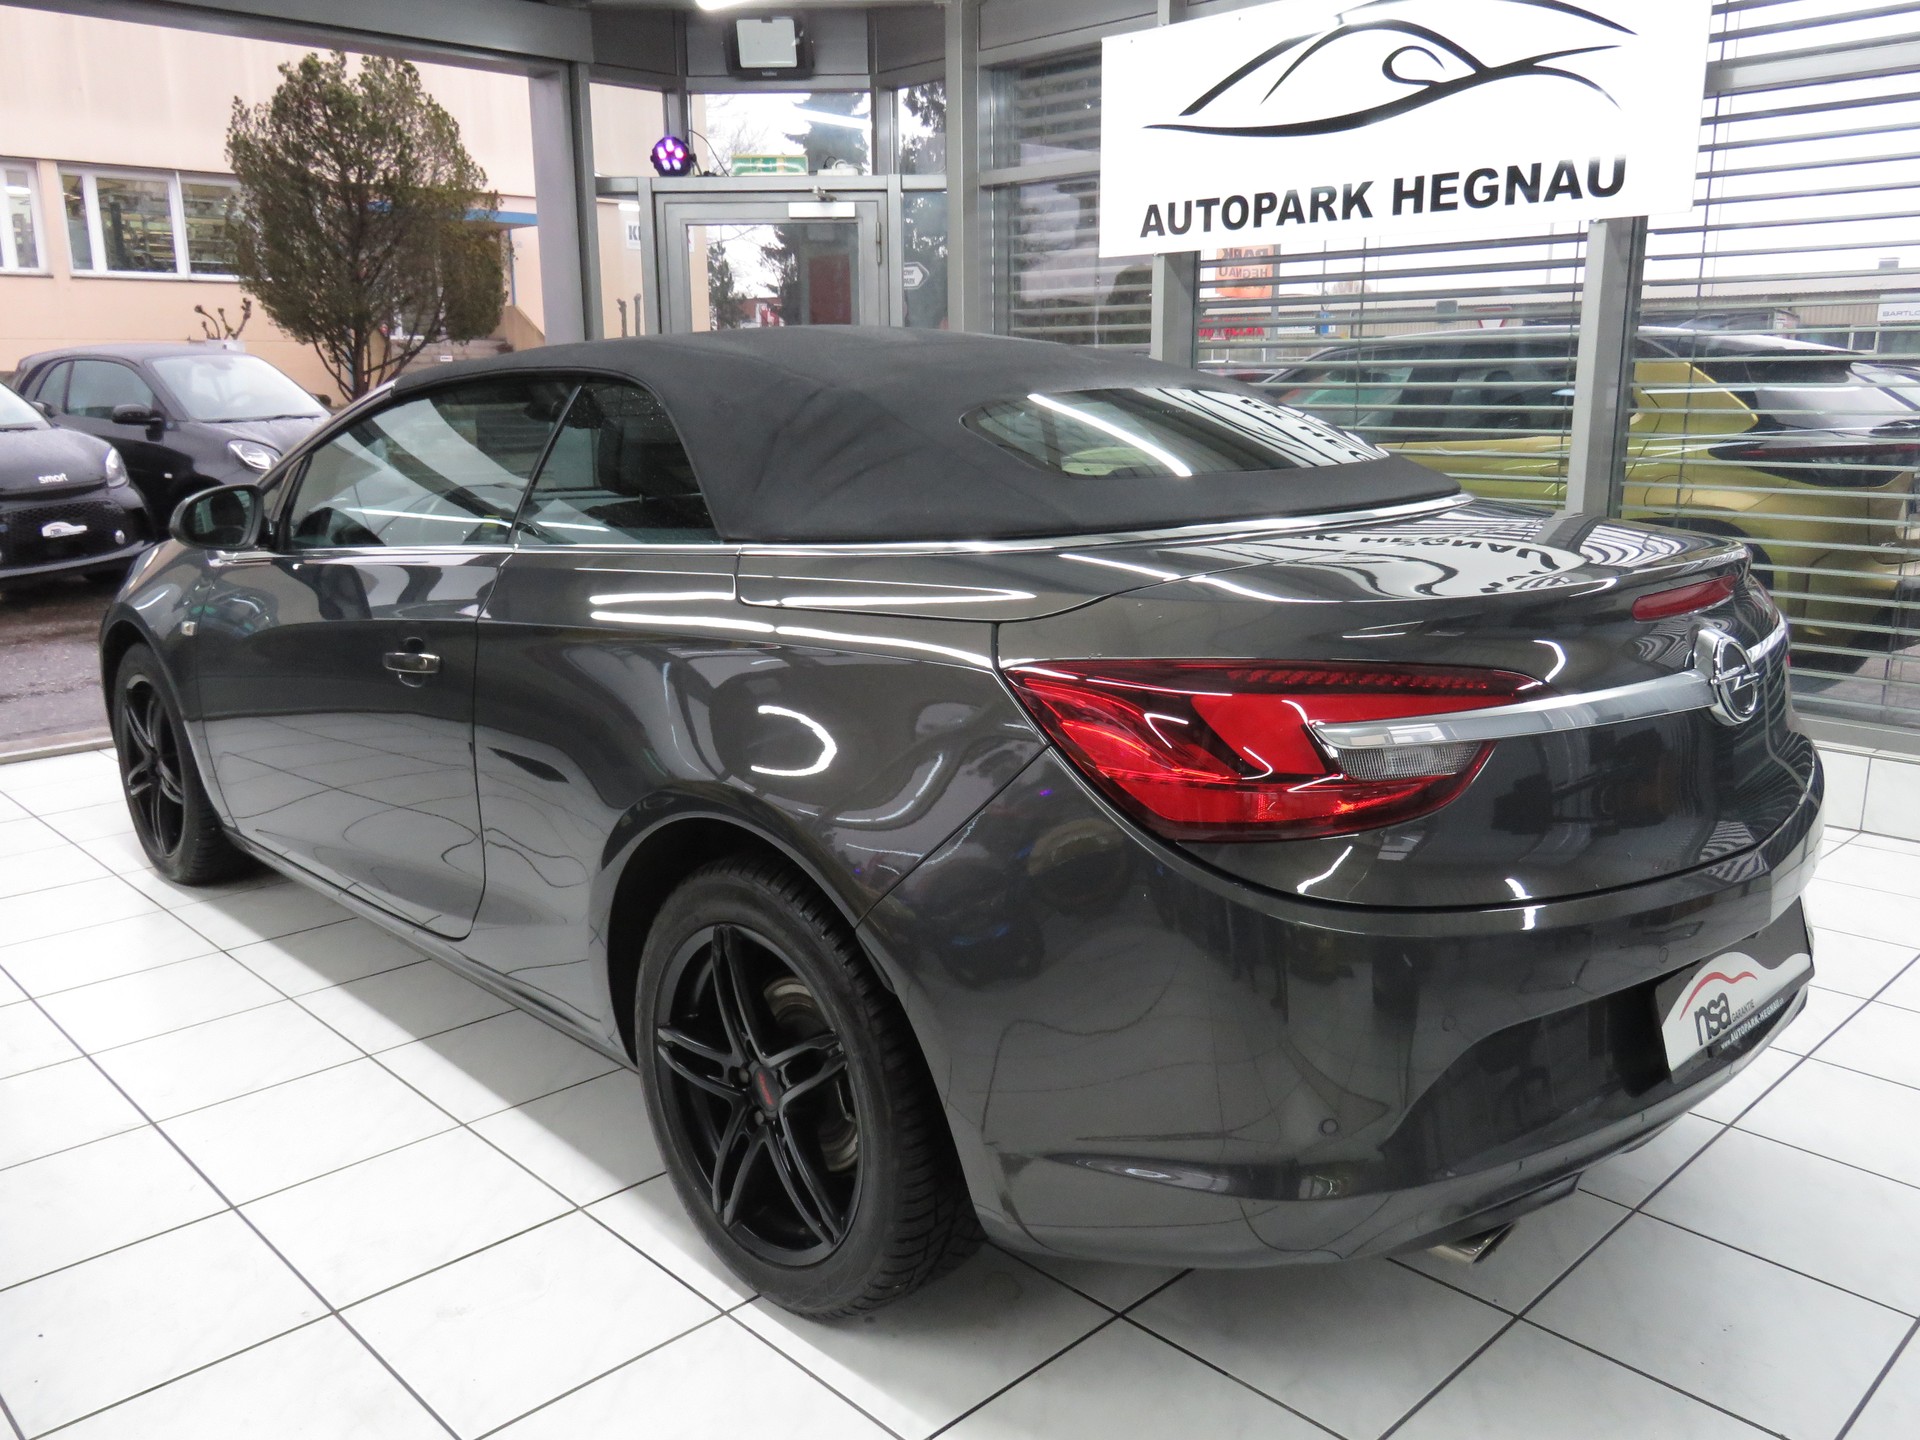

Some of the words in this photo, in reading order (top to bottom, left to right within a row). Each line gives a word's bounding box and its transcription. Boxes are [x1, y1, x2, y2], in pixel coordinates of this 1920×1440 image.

[1140, 181, 1373, 238] AUTOPARK
[1392, 154, 1627, 216] HEGNAU
[38, 473, 69, 484] smart
[1693, 992, 1732, 1046] nsa
